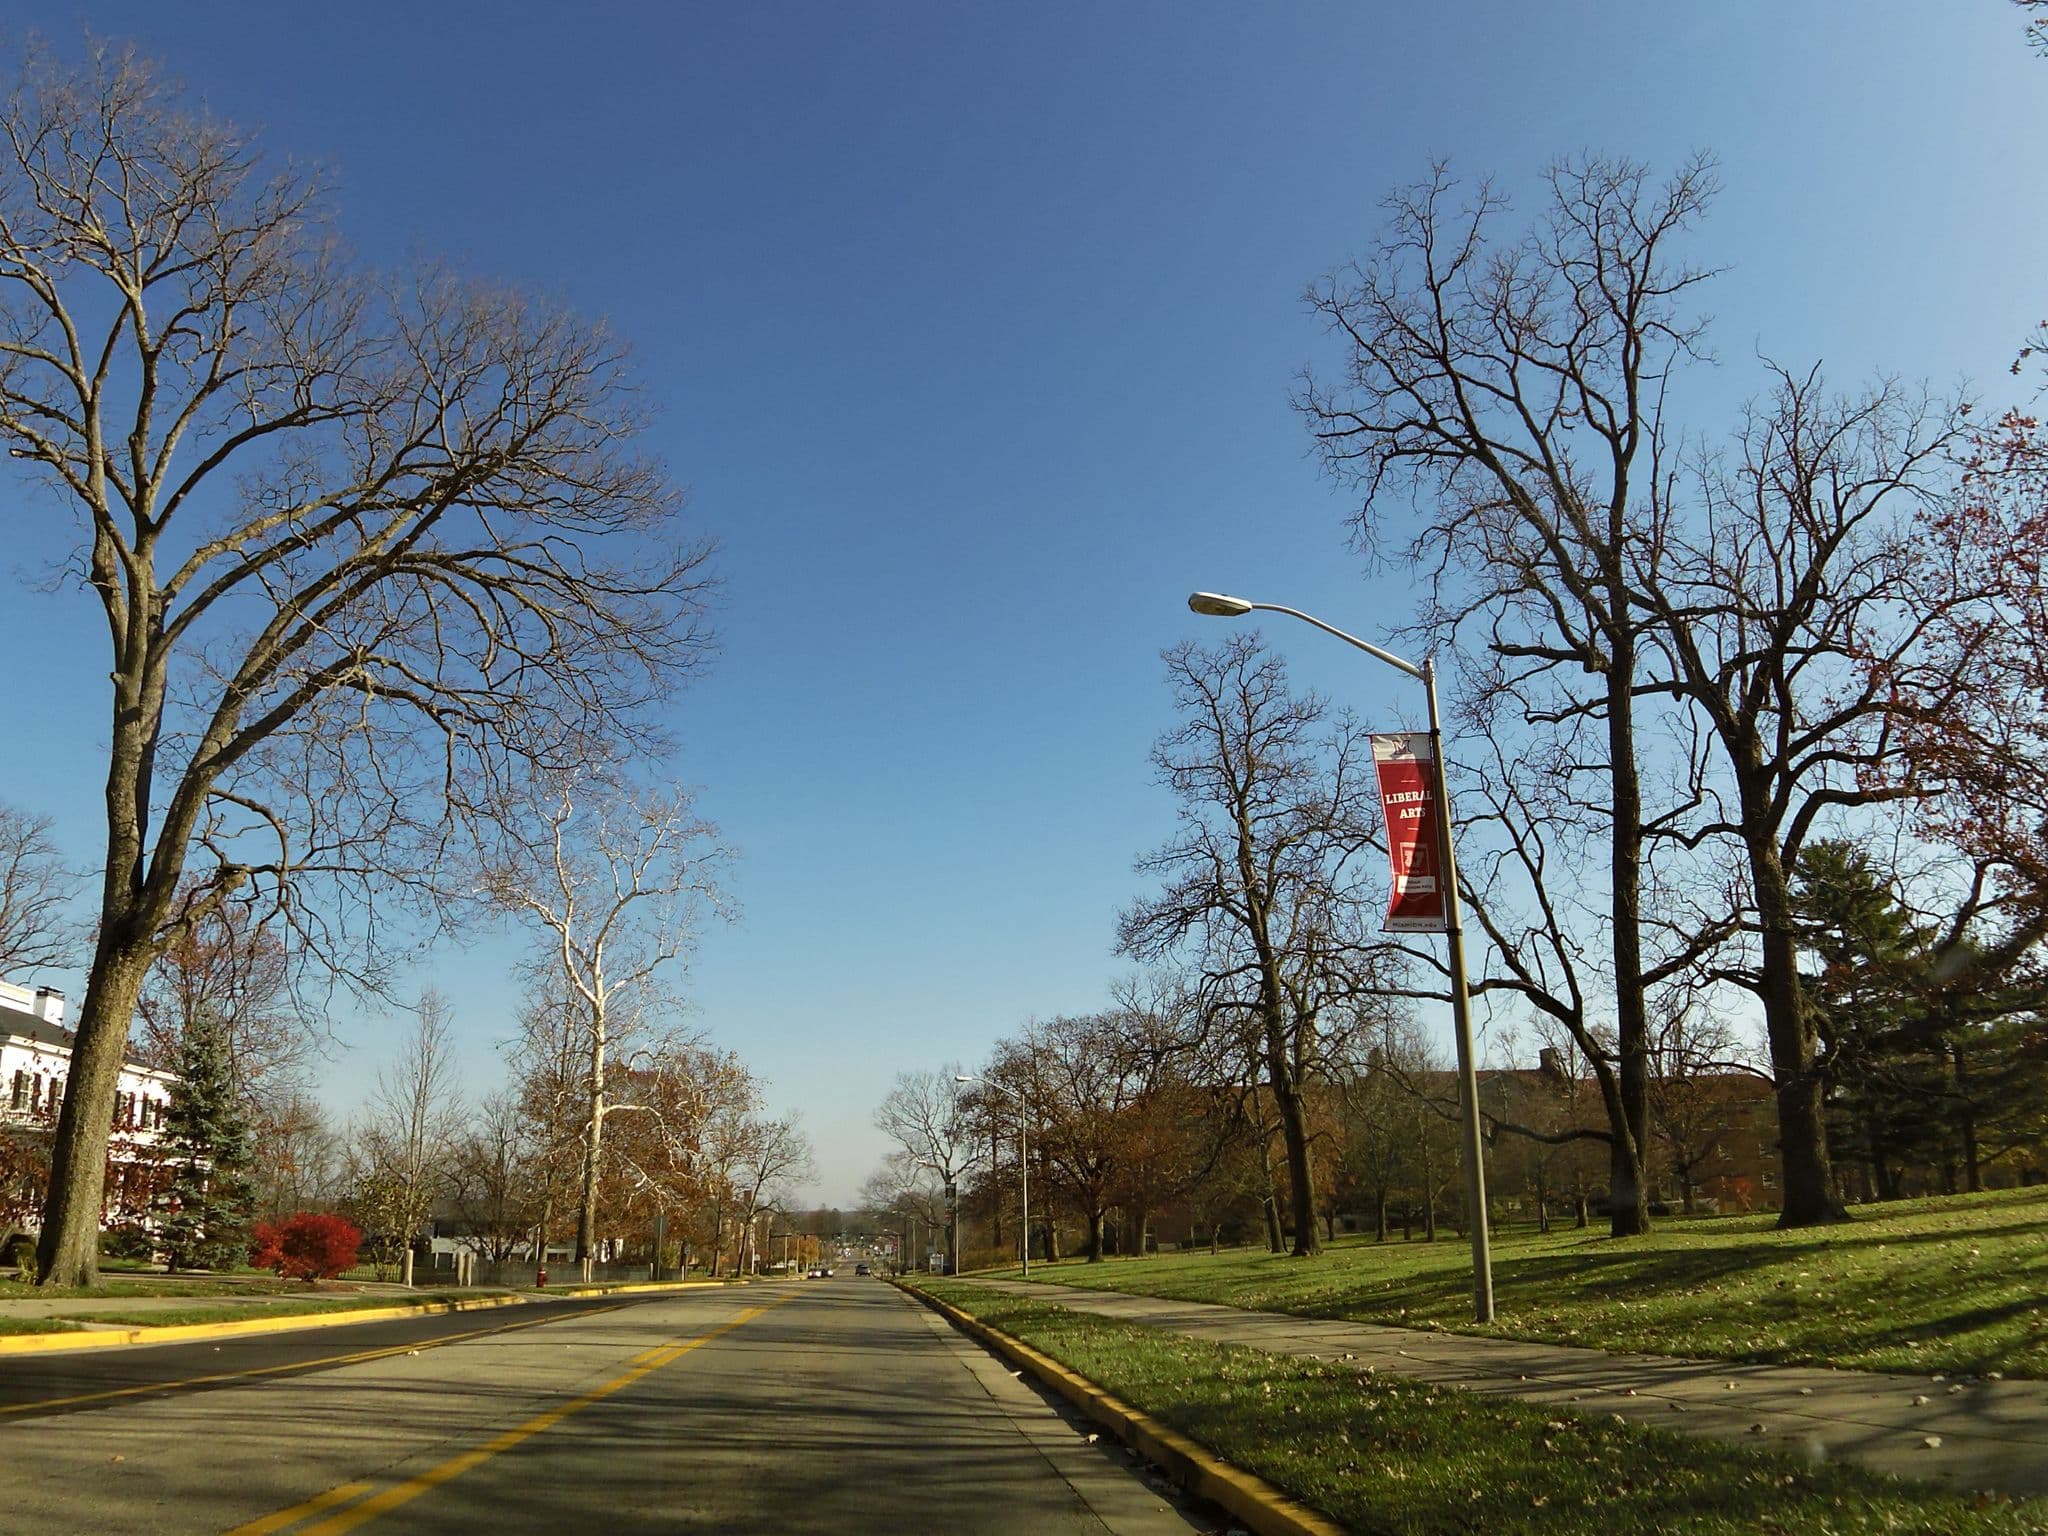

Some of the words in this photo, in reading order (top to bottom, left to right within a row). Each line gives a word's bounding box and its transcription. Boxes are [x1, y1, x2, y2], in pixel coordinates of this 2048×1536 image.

[1391, 740, 1412, 754] M
[1385, 790, 1432, 804] LIBERAL
[1400, 807, 1426, 819] ARTS
